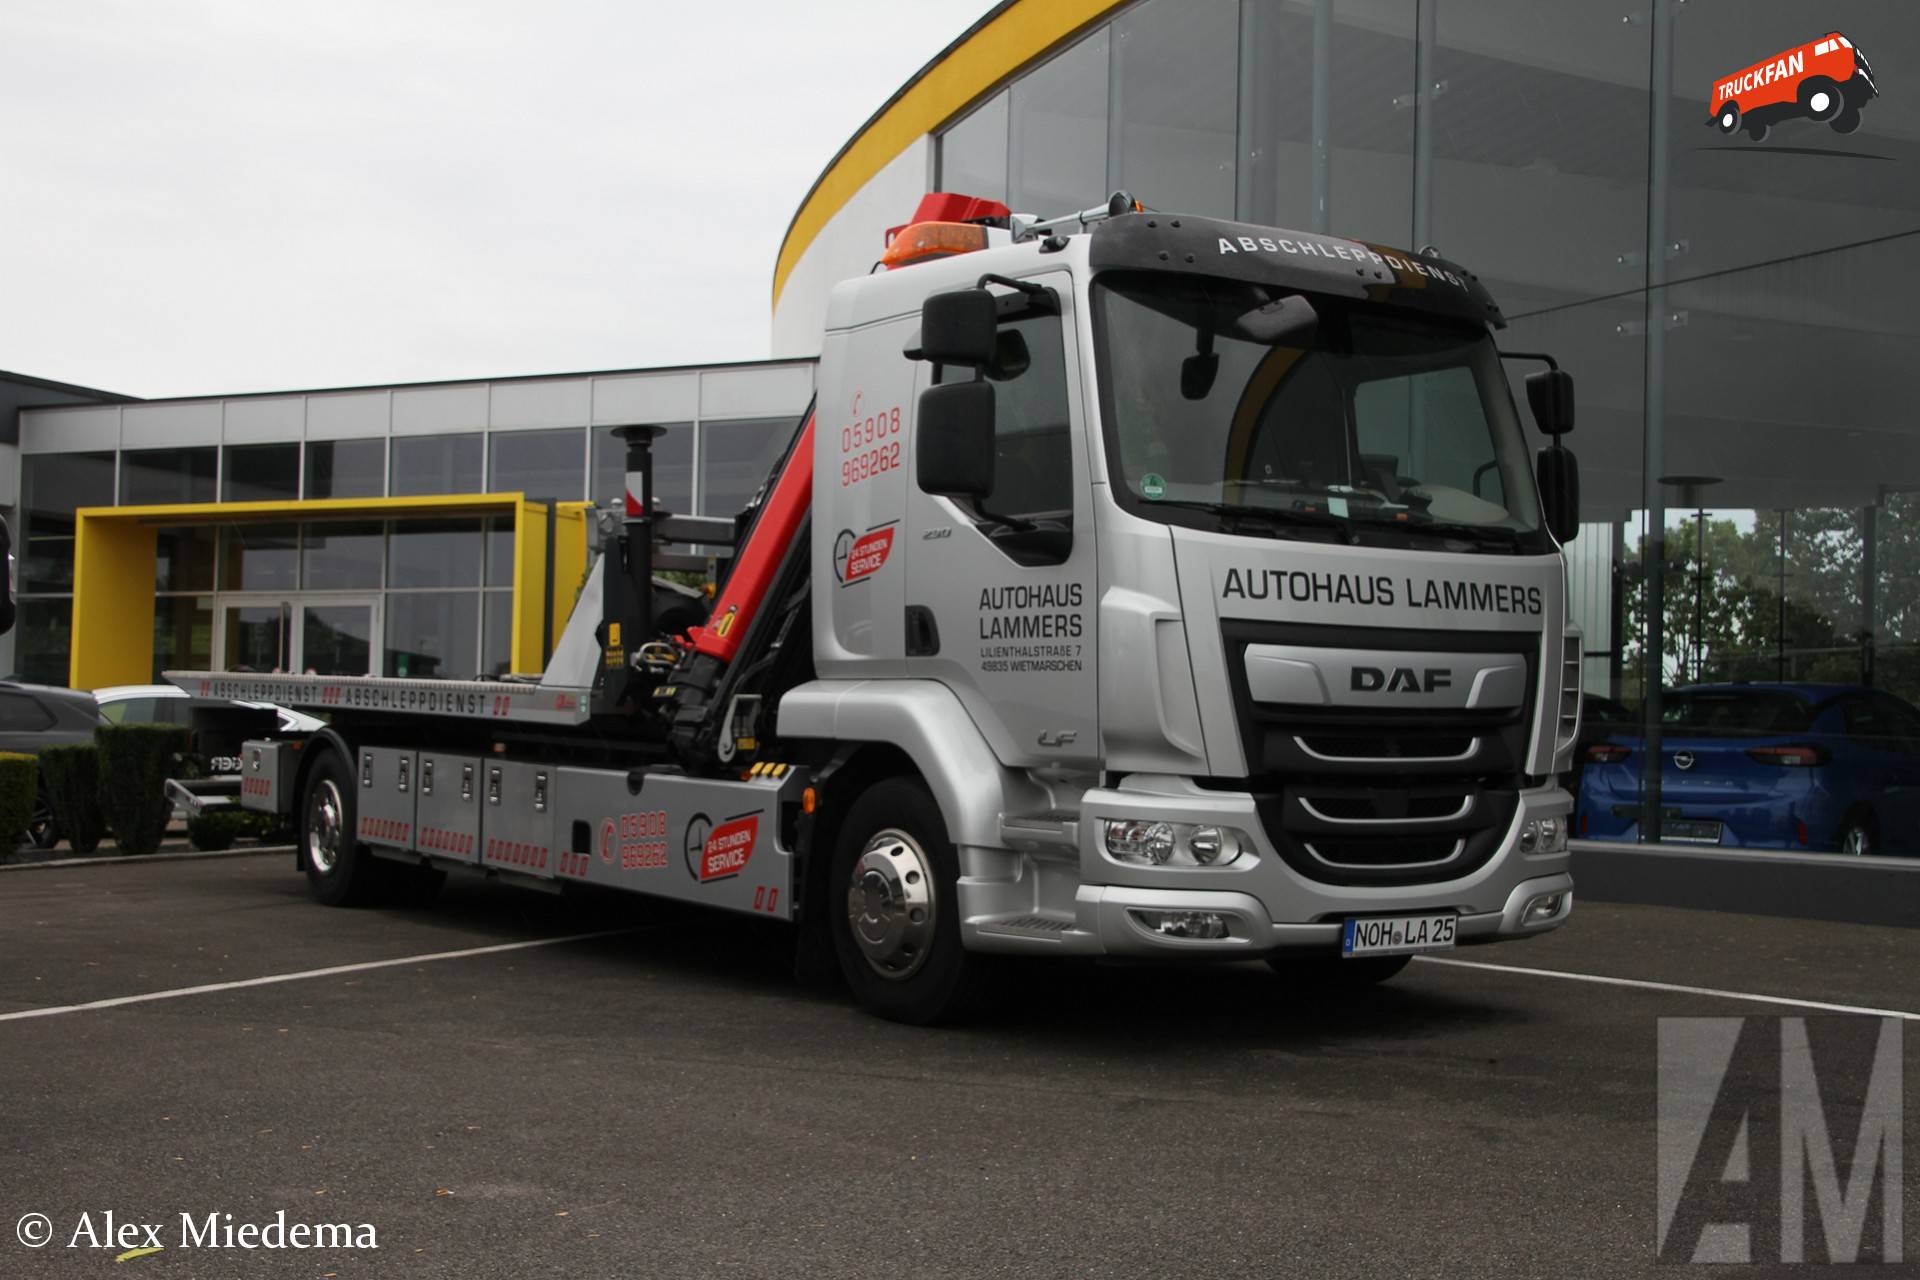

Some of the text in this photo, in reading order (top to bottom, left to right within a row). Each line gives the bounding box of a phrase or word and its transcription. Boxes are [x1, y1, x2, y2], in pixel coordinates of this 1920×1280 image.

[1218, 236, 1469, 293] ABSCHLEPPDIENST
[842, 407, 900, 453] 05908
[842, 441, 900, 487] 969262
[850, 553, 881, 575] SERVICE
[979, 583, 1082, 611] AUTOHAUS
[1222, 568, 1542, 615] AUTOHAUS LAMMERS
[980, 614, 1082, 640] LAMMERS
[1075, 645, 1082, 656] 7
[1010, 660, 1082, 672] WIETMARSCHEN
[214, 682, 317, 702] ABSCHLEPPDIENST
[1351, 666, 1452, 693] DAF
[346, 688, 486, 714] ABSCHLEPPDIENST
[1038, 728, 1078, 748] LF
[621, 810, 666, 839] 05908
[707, 830, 752, 853] 24 STUNDEN
[708, 848, 744, 872] SERVICE
[1354, 921, 1393, 947] NOH
[1404, 920, 1428, 944] LA
[1432, 918, 1455, 943] 25
